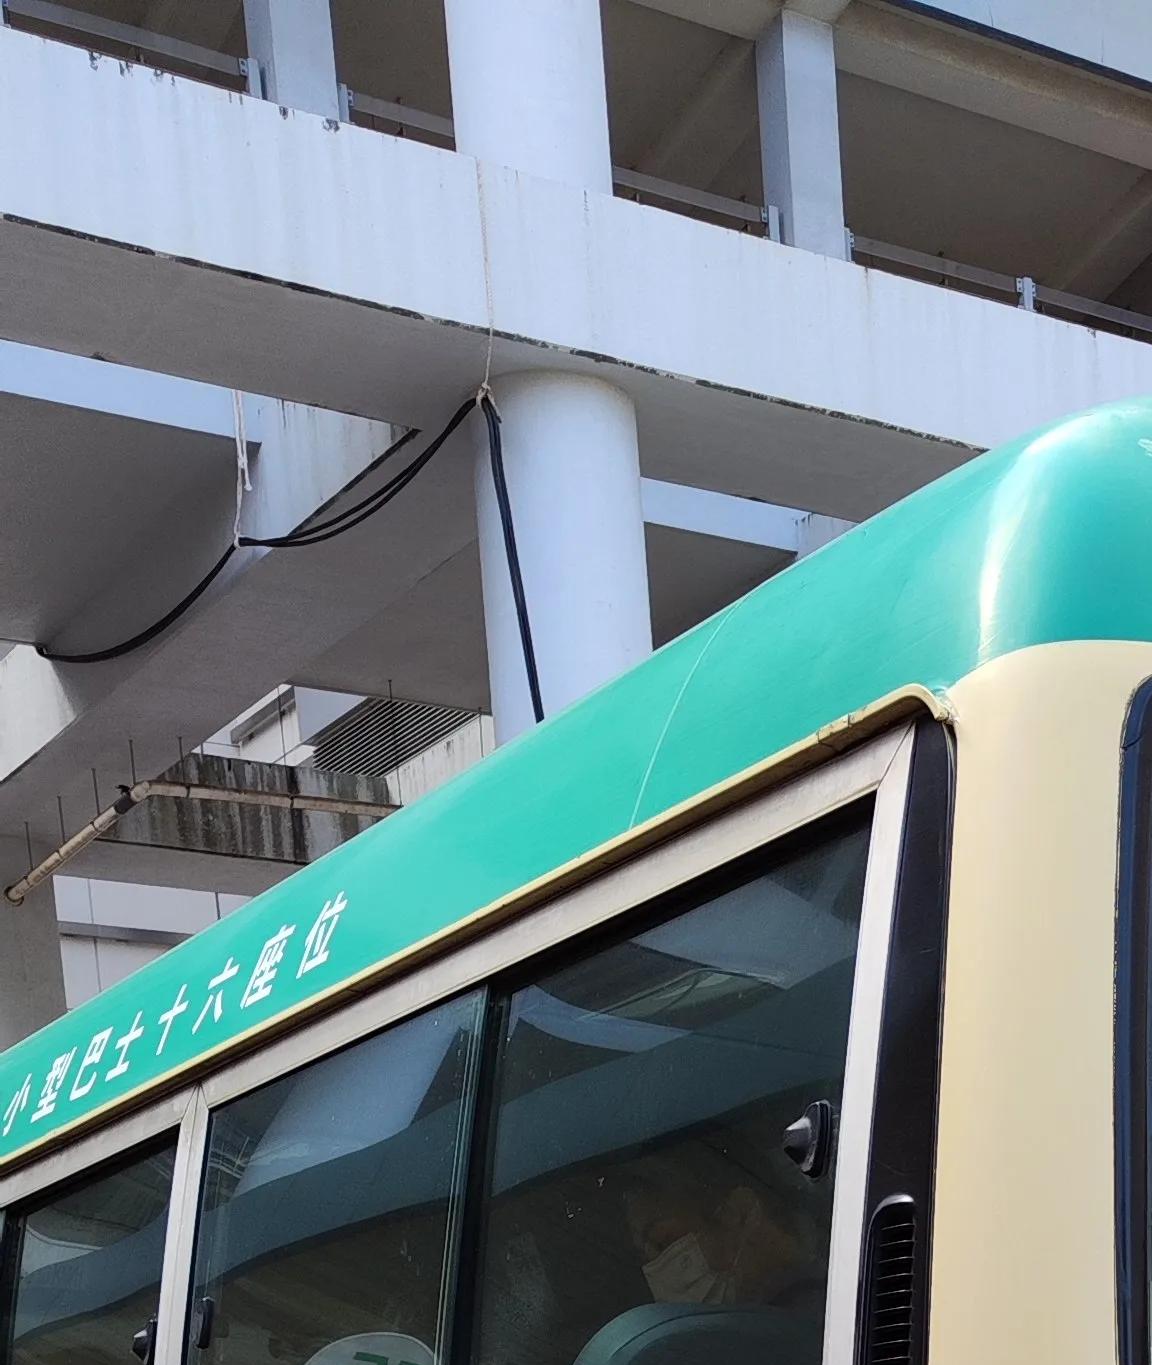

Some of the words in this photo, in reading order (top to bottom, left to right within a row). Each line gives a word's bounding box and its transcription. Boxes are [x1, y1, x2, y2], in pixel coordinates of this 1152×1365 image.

[3, 891, 347, 1136] 小型巴士十六座位
